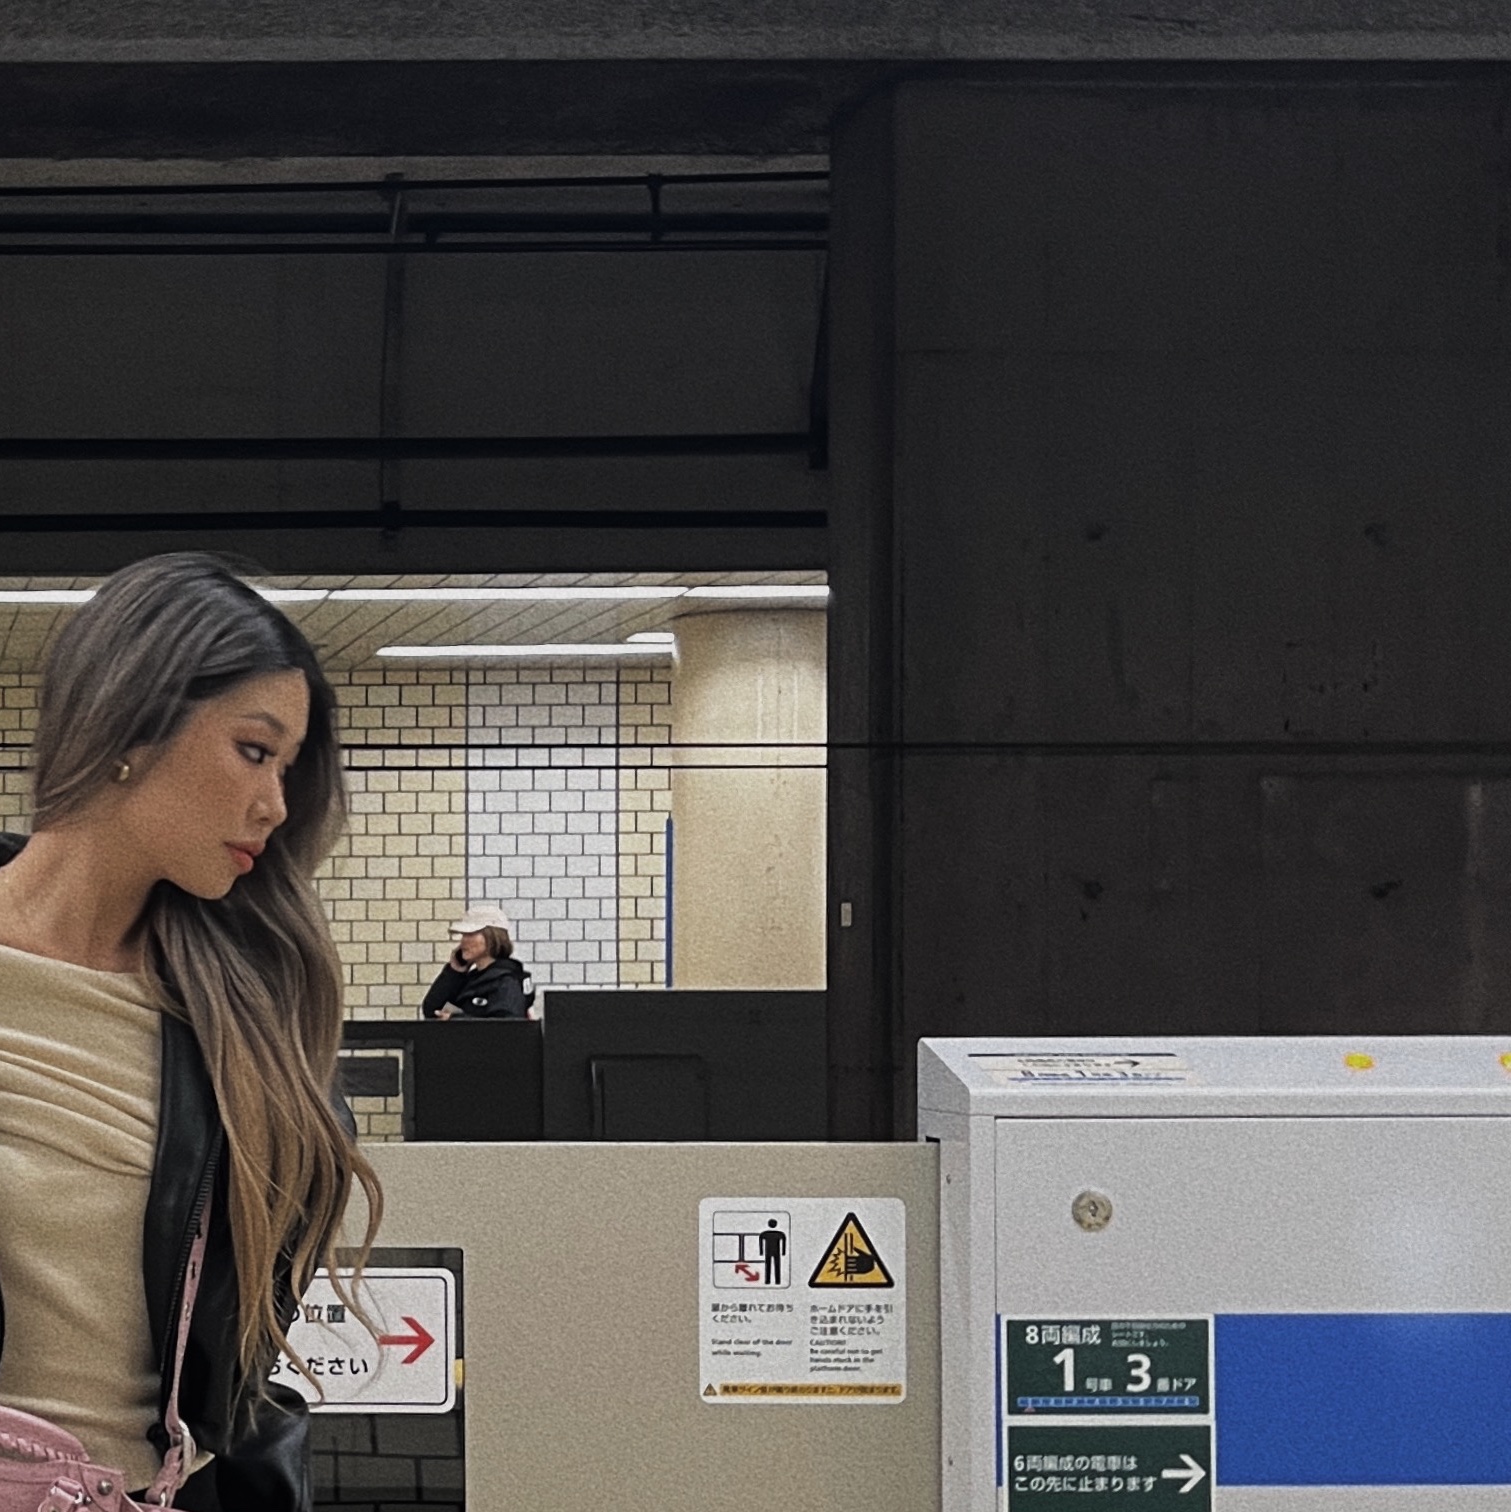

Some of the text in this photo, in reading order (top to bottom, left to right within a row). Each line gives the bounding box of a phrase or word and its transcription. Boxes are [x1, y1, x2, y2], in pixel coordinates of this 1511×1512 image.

[1025, 1324, 1102, 1345] 8両編成
[1053, 1347, 1075, 1392] 1
[1126, 1353, 1151, 1393] 3
[1013, 1454, 1138, 1472] 6両編成の電車は
[1014, 1476, 1158, 1493] この先に止まります
